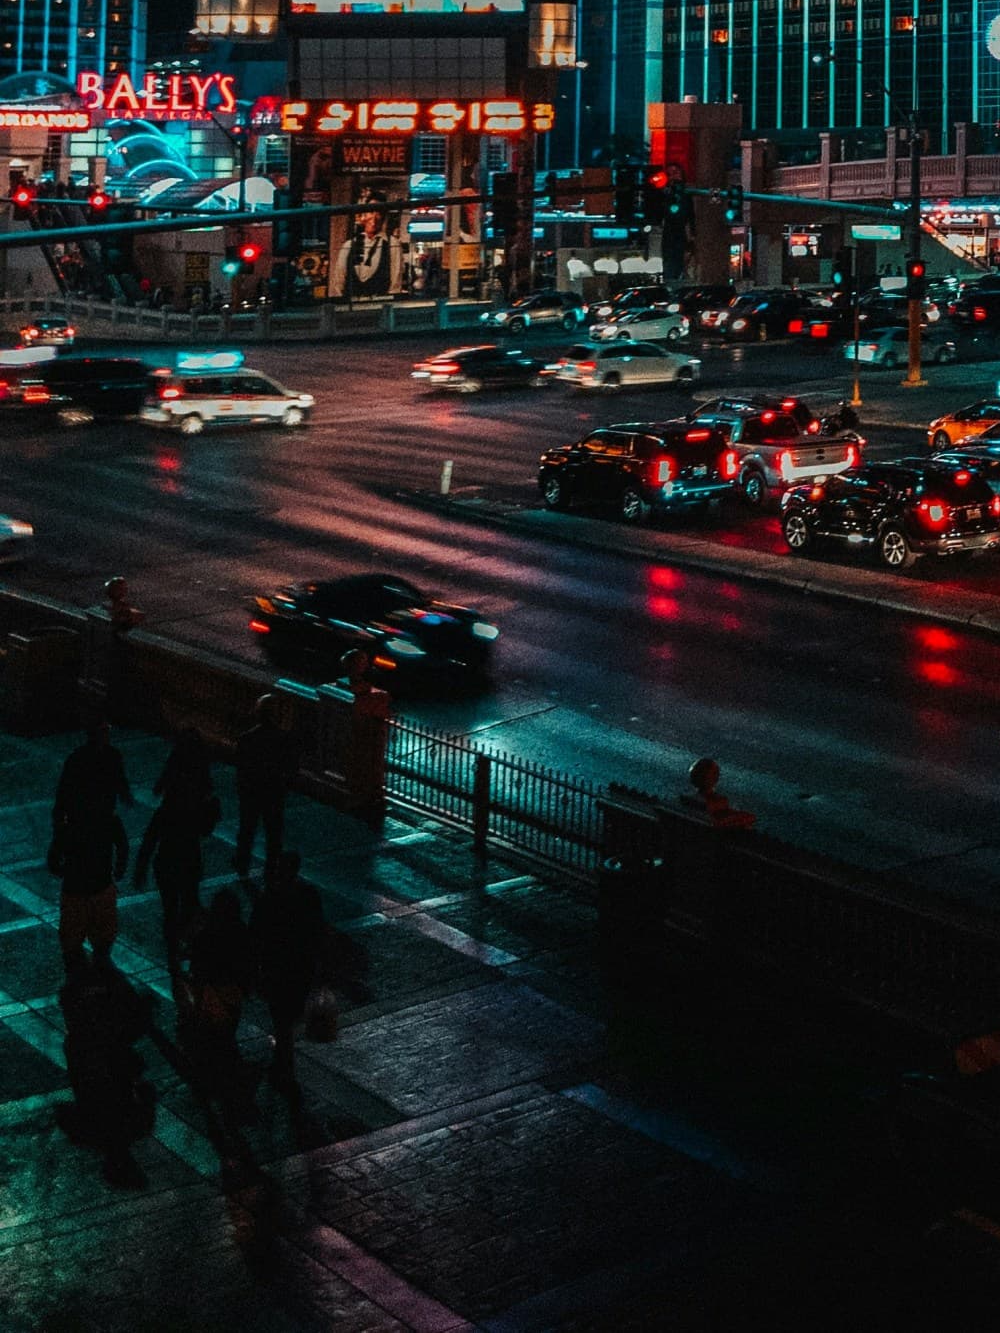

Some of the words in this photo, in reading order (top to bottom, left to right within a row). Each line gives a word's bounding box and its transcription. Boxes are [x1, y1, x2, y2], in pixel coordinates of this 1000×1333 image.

[78, 70, 236, 113] BALLY'S
[111, 110, 145, 120] LAS
[155, 110, 213, 121] VEGAS
[343, 146, 405, 163] WAYNE
